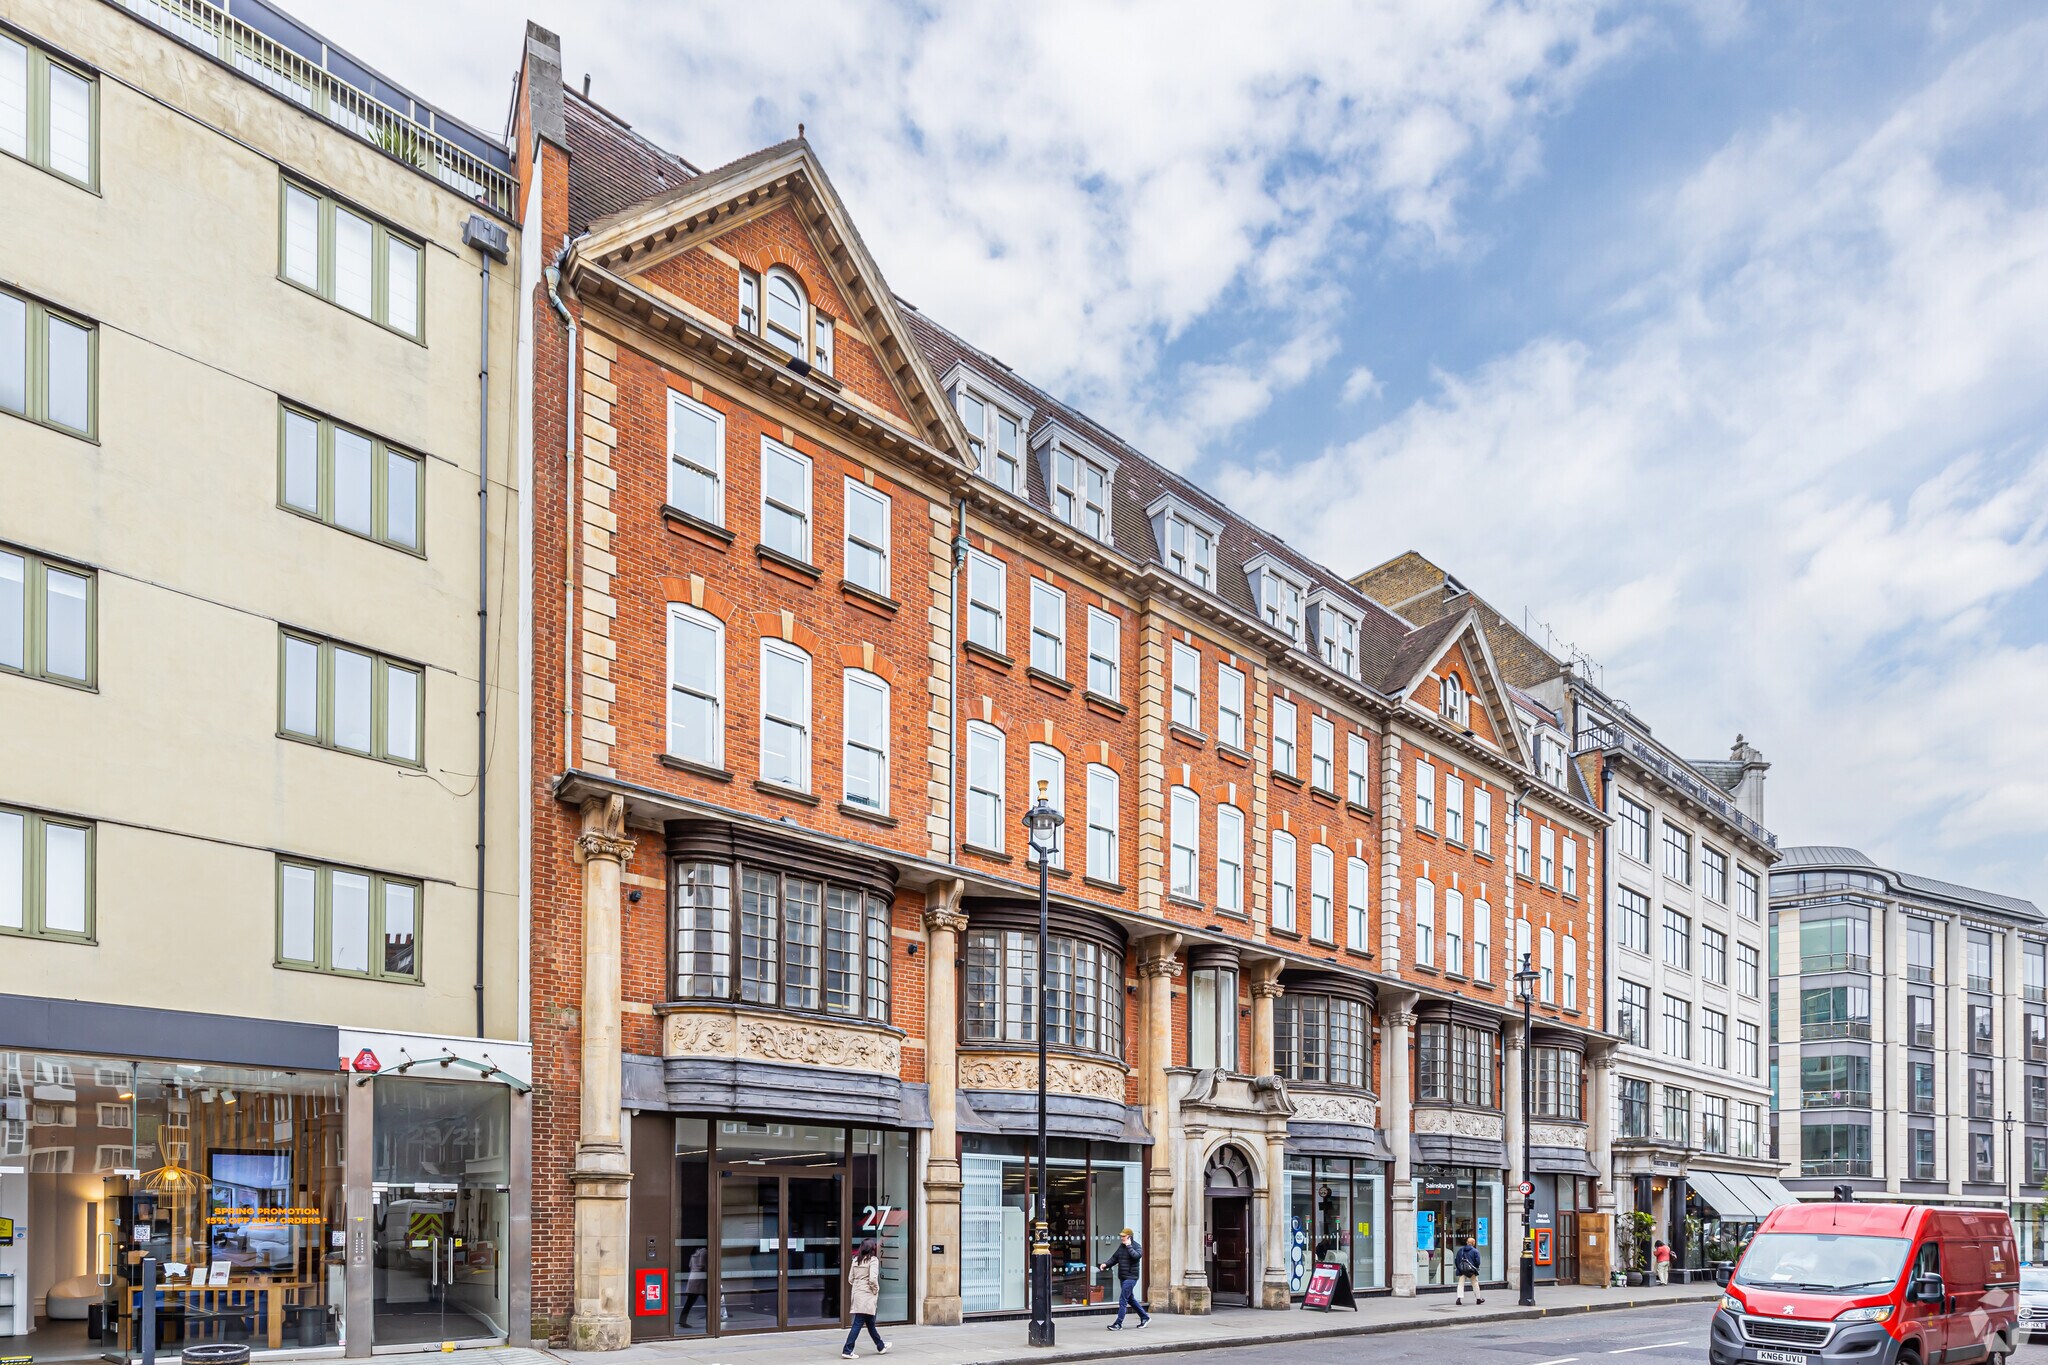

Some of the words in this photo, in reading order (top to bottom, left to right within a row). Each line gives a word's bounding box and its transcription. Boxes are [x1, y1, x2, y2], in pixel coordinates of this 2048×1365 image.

[214, 1207, 254, 1215] SPRING
[257, 1207, 319, 1215] PROMOTION
[205, 1217, 226, 1225] 15%
[229, 1217, 250, 1225] OFF
[252, 1217, 278, 1225] NEW
[280, 1217, 321, 1225] ORDERS
[862, 1206, 892, 1230] 27
[1761, 1351, 1784, 1361] KN66
[1785, 1354, 1803, 1363] UVU
